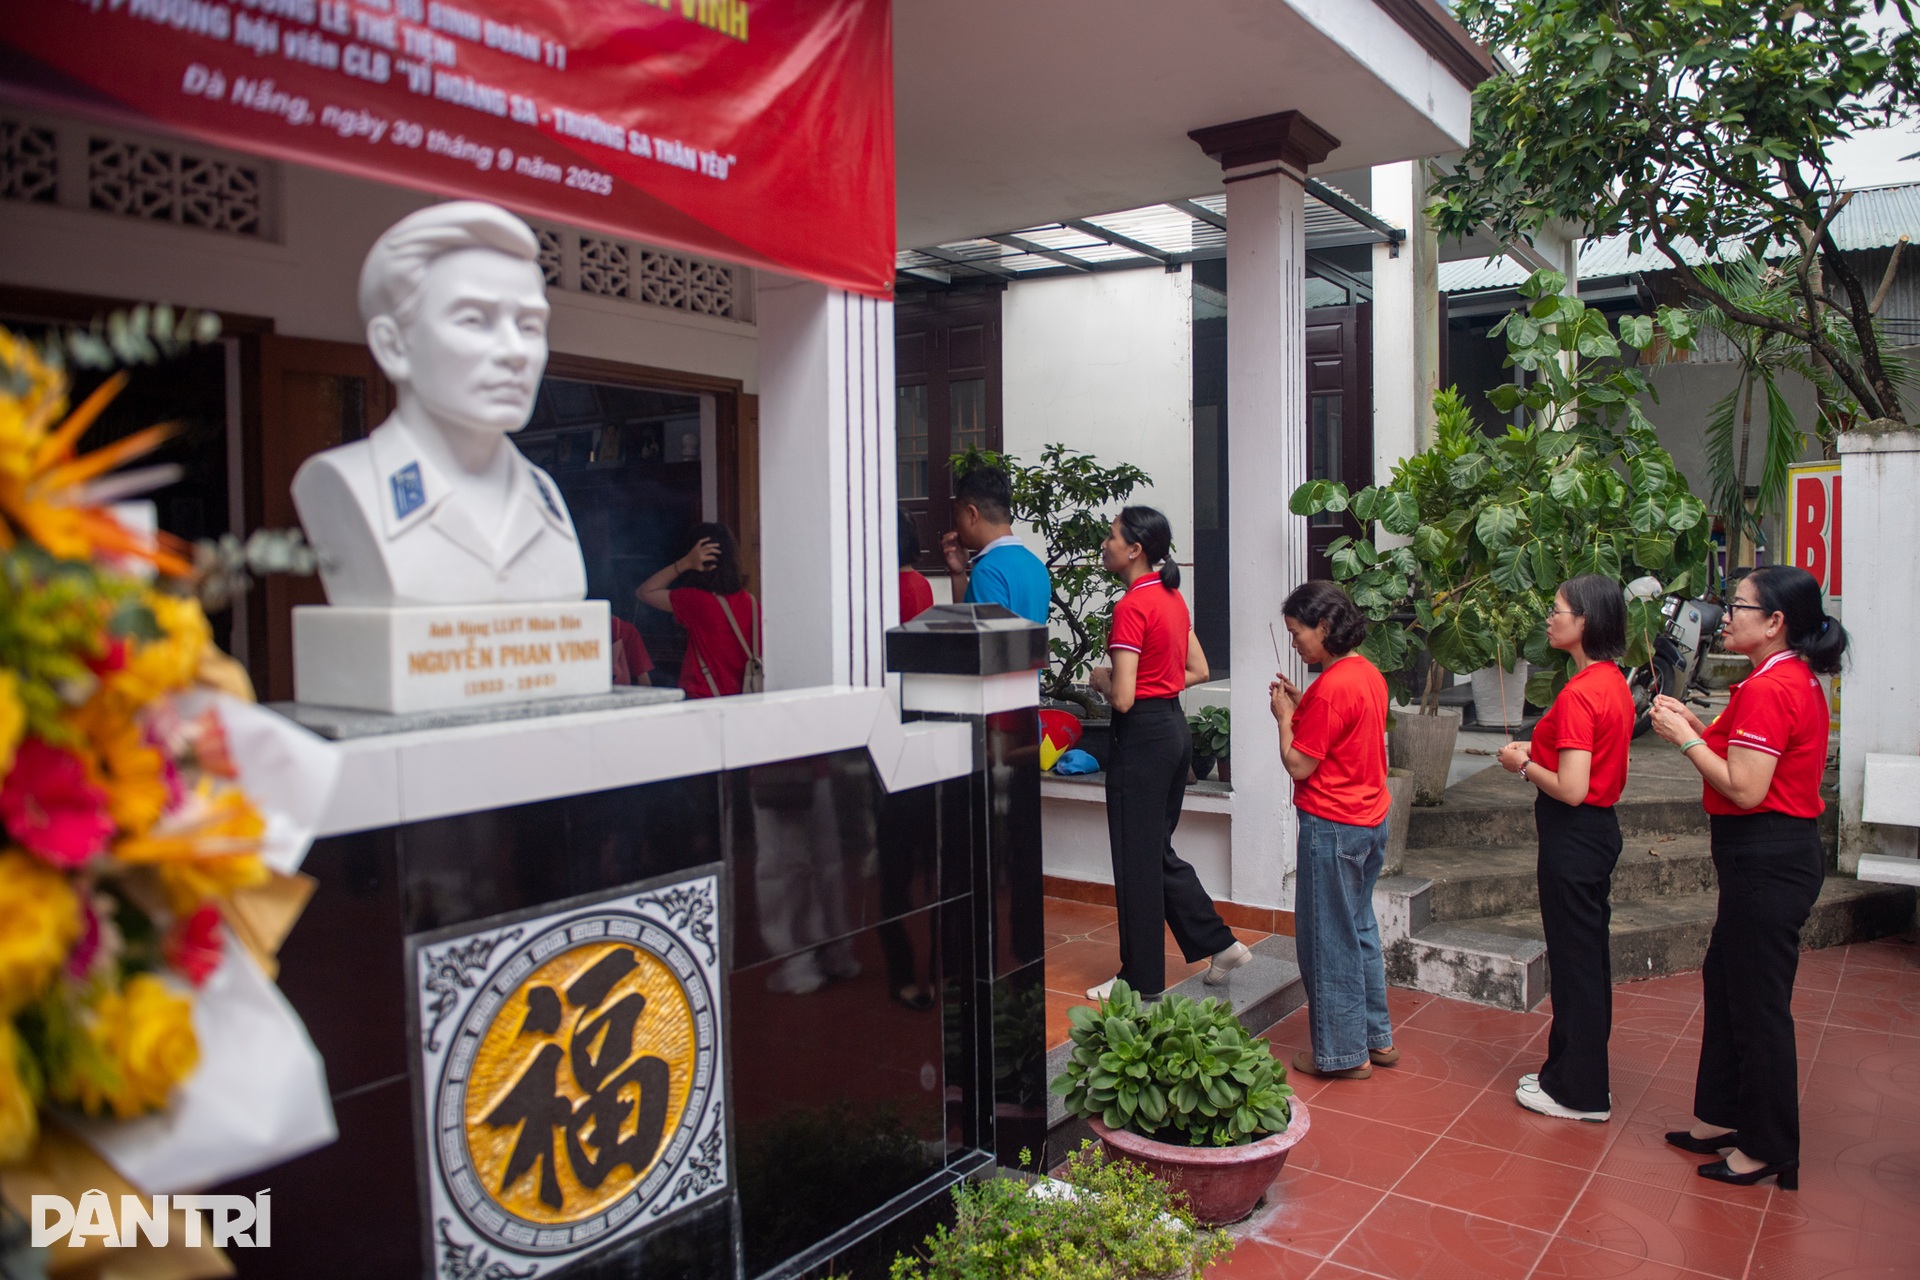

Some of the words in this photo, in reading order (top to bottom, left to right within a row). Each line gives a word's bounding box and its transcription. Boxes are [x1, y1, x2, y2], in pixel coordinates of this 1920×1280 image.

[341, 43, 391, 83] CLB
[509, 94, 539, 126] SA
[627, 129, 653, 159] SA
[320, 104, 390, 145] ngày
[390, 118, 424, 148] 30
[425, 128, 495, 172] tháng
[496, 147, 515, 170] 9
[515, 154, 563, 184] năm
[564, 164, 614, 196] 2025
[500, 643, 552, 668] PHAN
[556, 639, 600, 663] VINH
